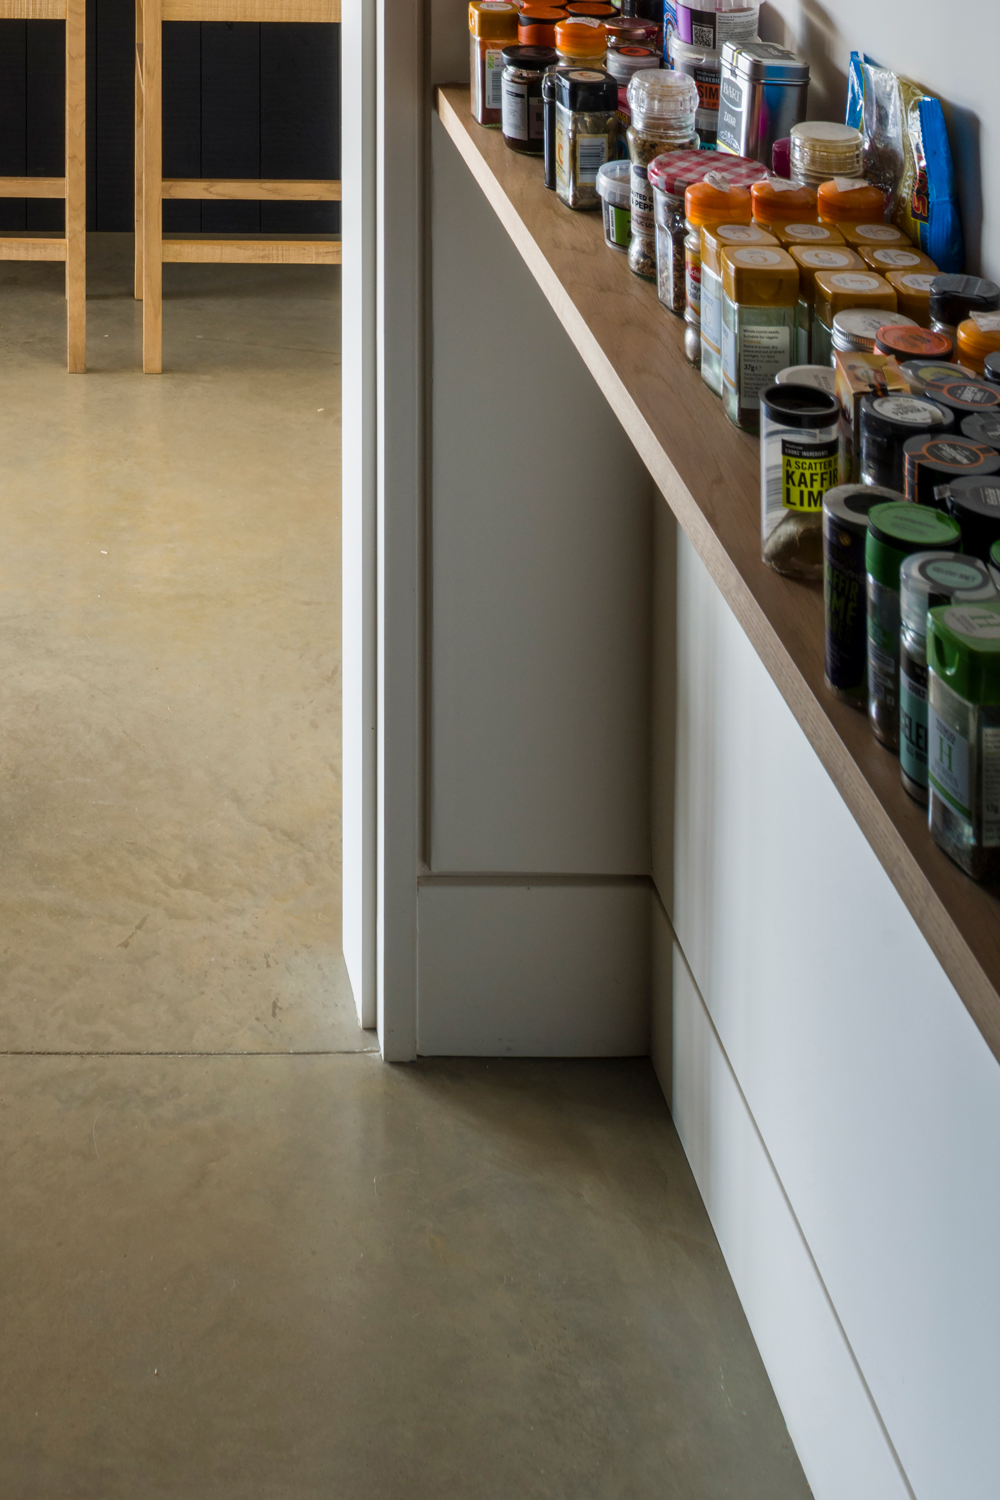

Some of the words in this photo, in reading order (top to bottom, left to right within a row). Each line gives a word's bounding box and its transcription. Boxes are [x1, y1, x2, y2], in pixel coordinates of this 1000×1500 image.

[723, 81, 741, 103] BART
[743, 363, 755, 372] 37g
[786, 459, 792, 469] A
[795, 460, 833, 471] SCATTER
[786, 468, 838, 489] KAFFIR
[938, 734, 953, 773] H
